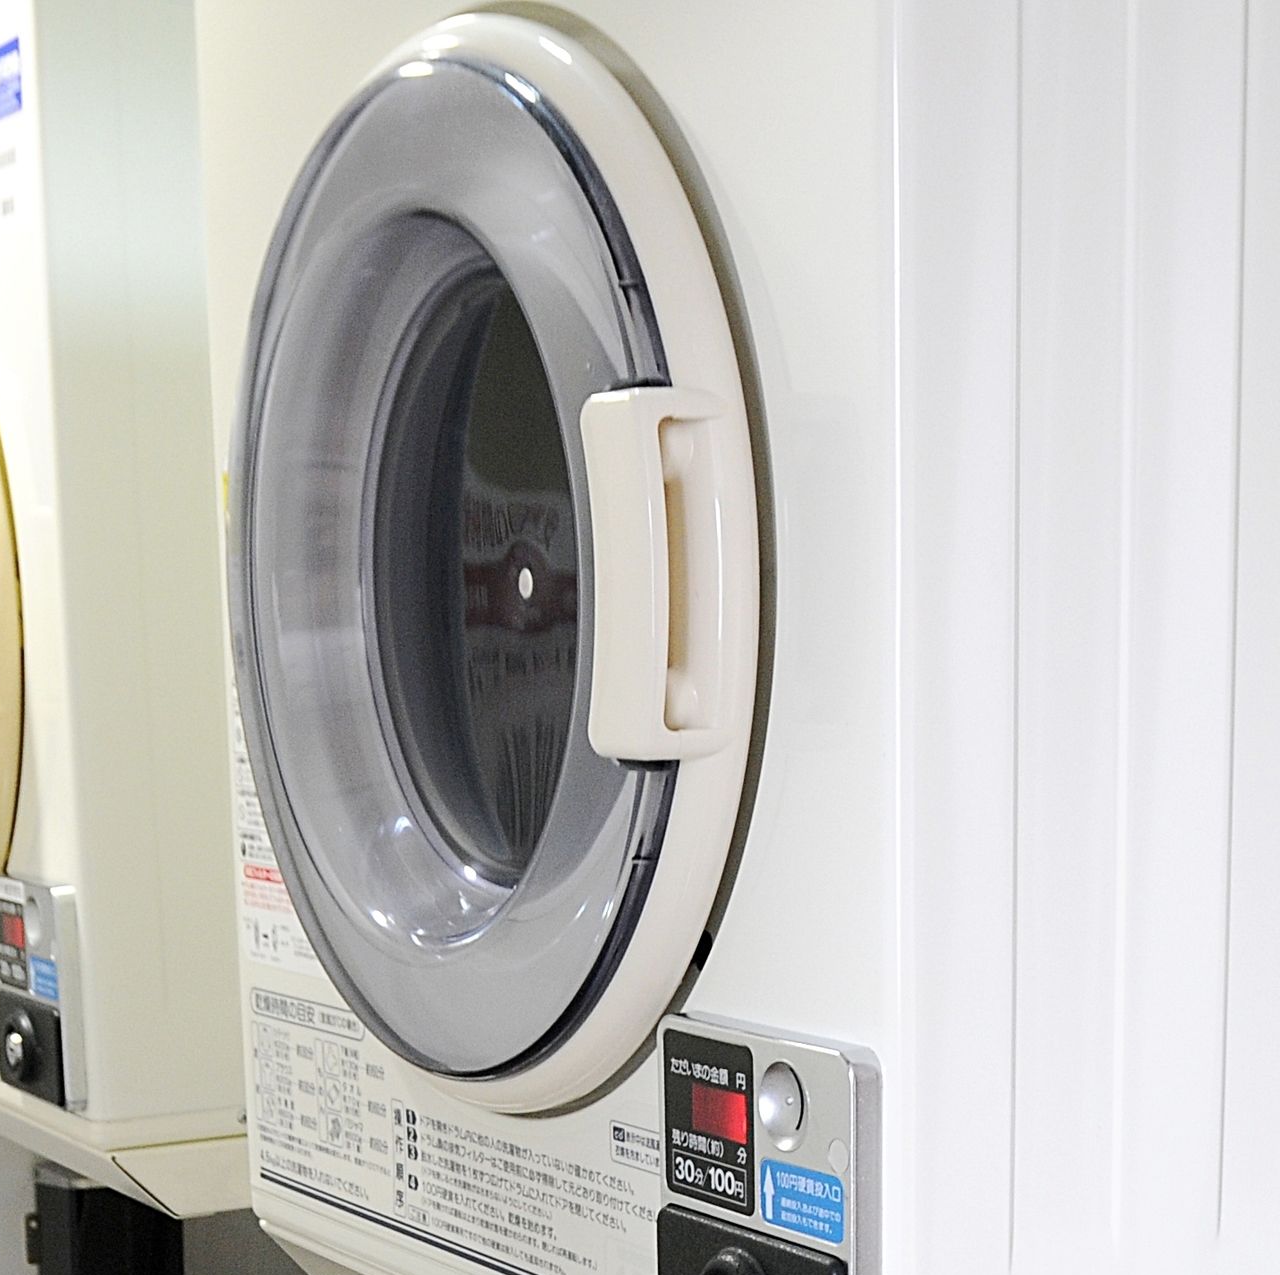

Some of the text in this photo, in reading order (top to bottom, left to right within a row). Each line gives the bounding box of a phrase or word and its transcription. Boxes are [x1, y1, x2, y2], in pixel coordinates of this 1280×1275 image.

[670, 1057, 729, 1086] ただいまの金額
[736, 1073, 746, 1090] 円
[737, 1147, 747, 1164] 分
[675, 1156, 744, 1199] 30分/100円
